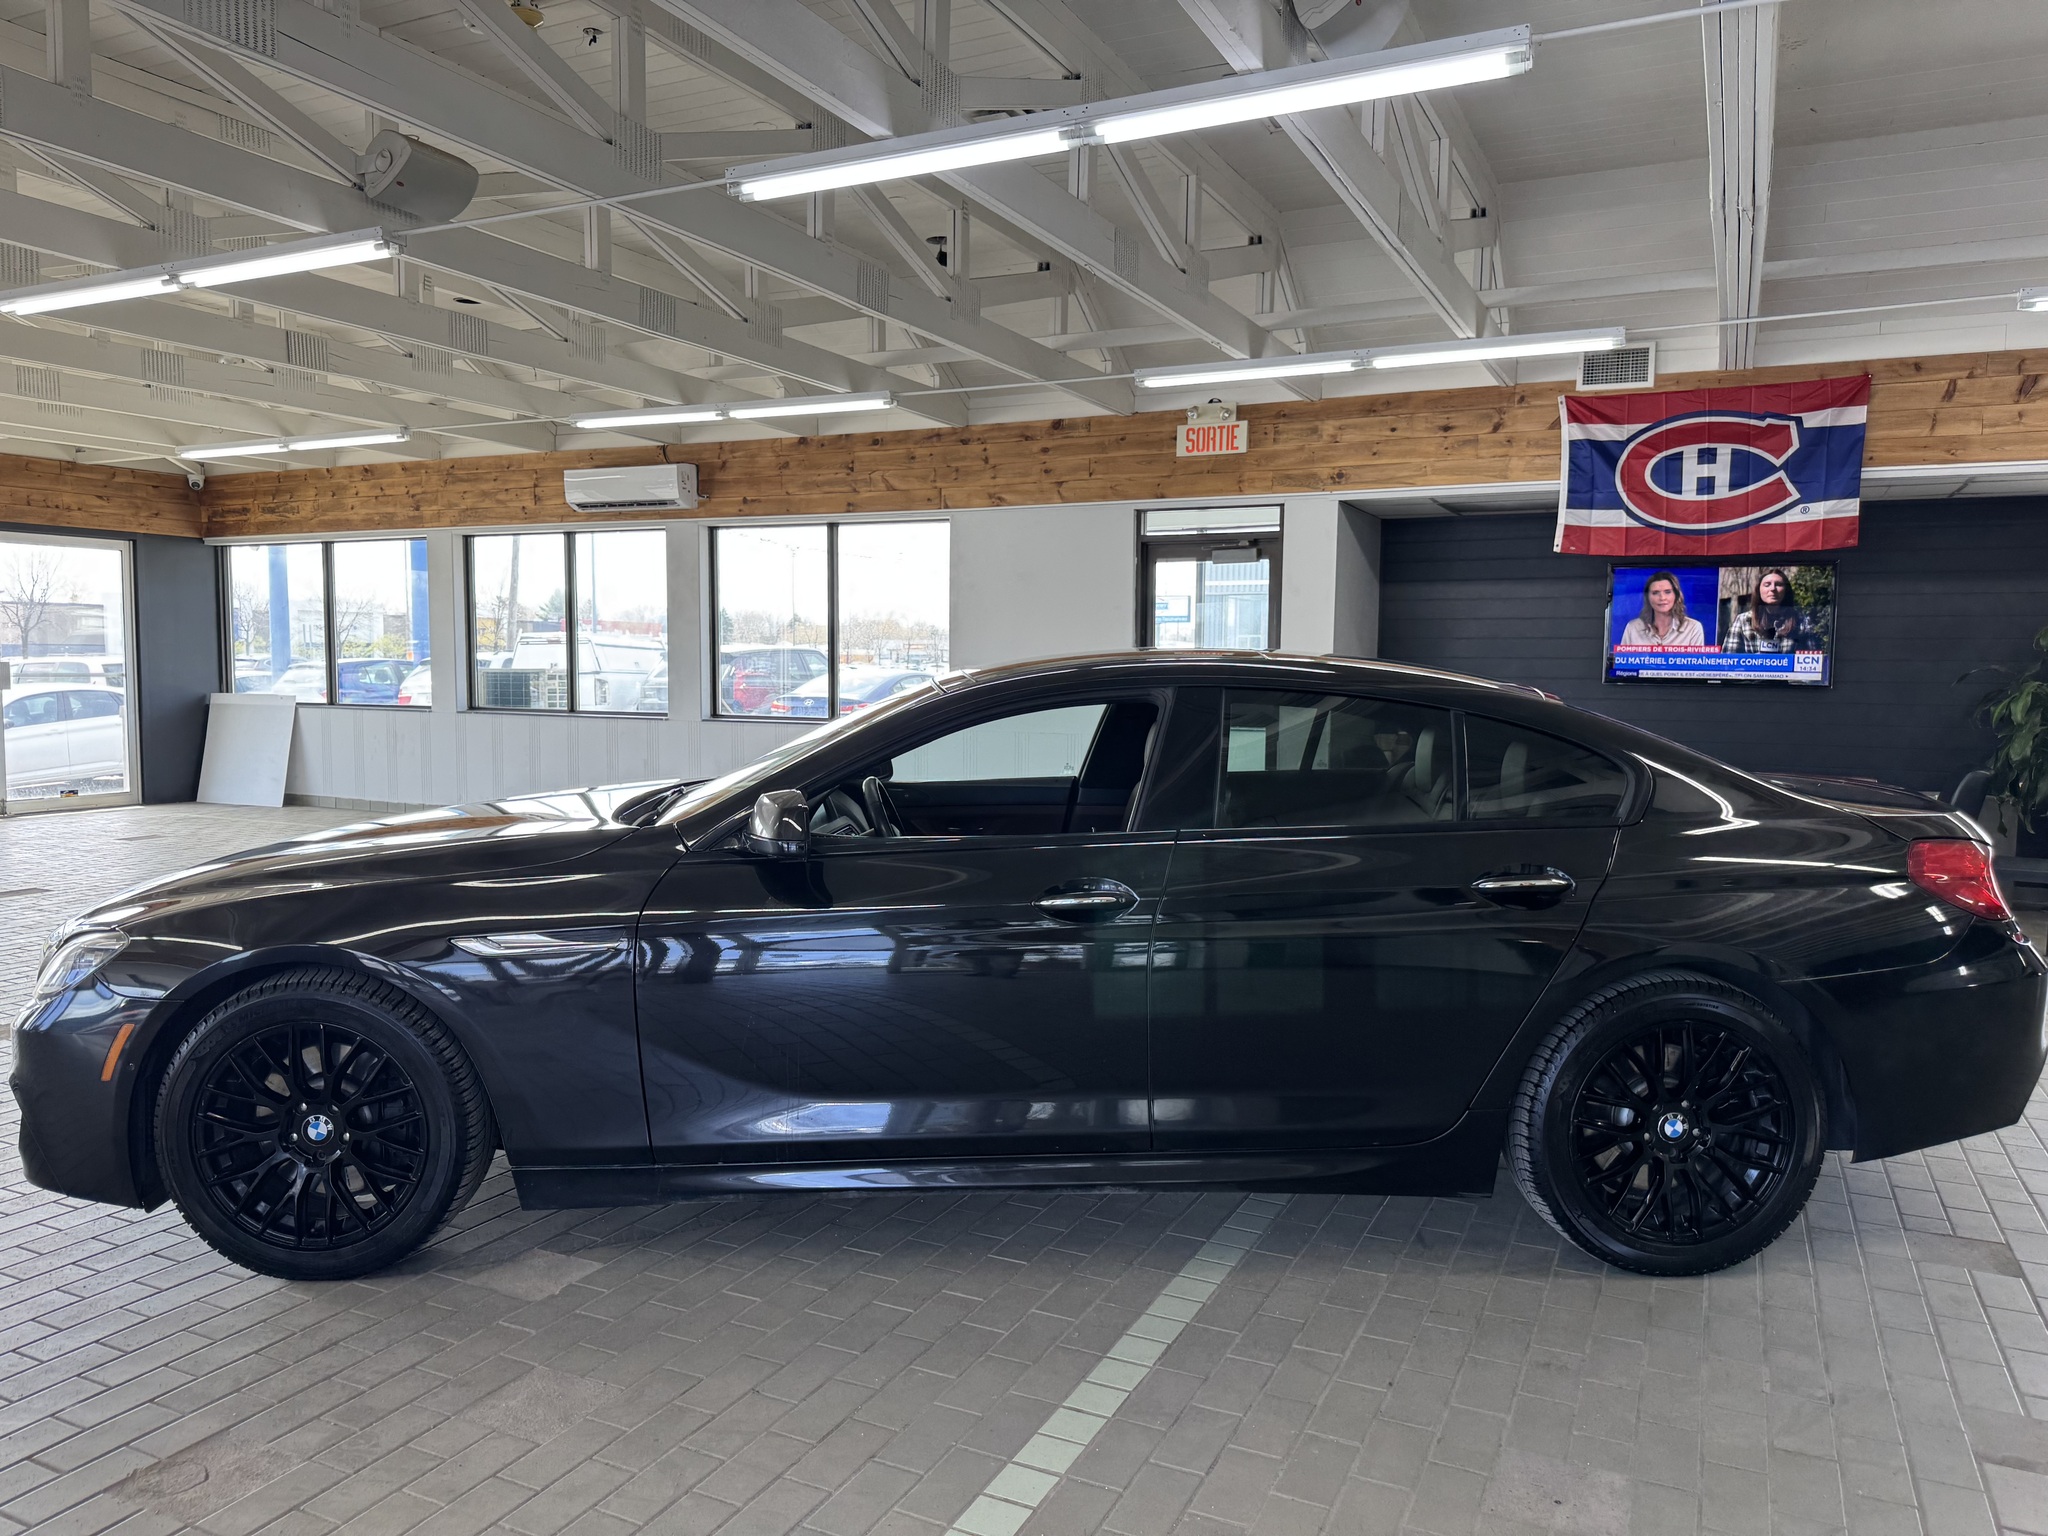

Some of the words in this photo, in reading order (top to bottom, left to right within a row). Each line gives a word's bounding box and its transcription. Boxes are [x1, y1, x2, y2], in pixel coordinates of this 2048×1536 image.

[1185, 424, 1240, 453] SORTIE
[1628, 656, 1666, 664] MATÉRIEL
[1669, 656, 1738, 665] D'ENTRAÎNEMENT
[1740, 657, 1788, 667] CONFISQUÉ
[1797, 656, 1820, 664] LCN
